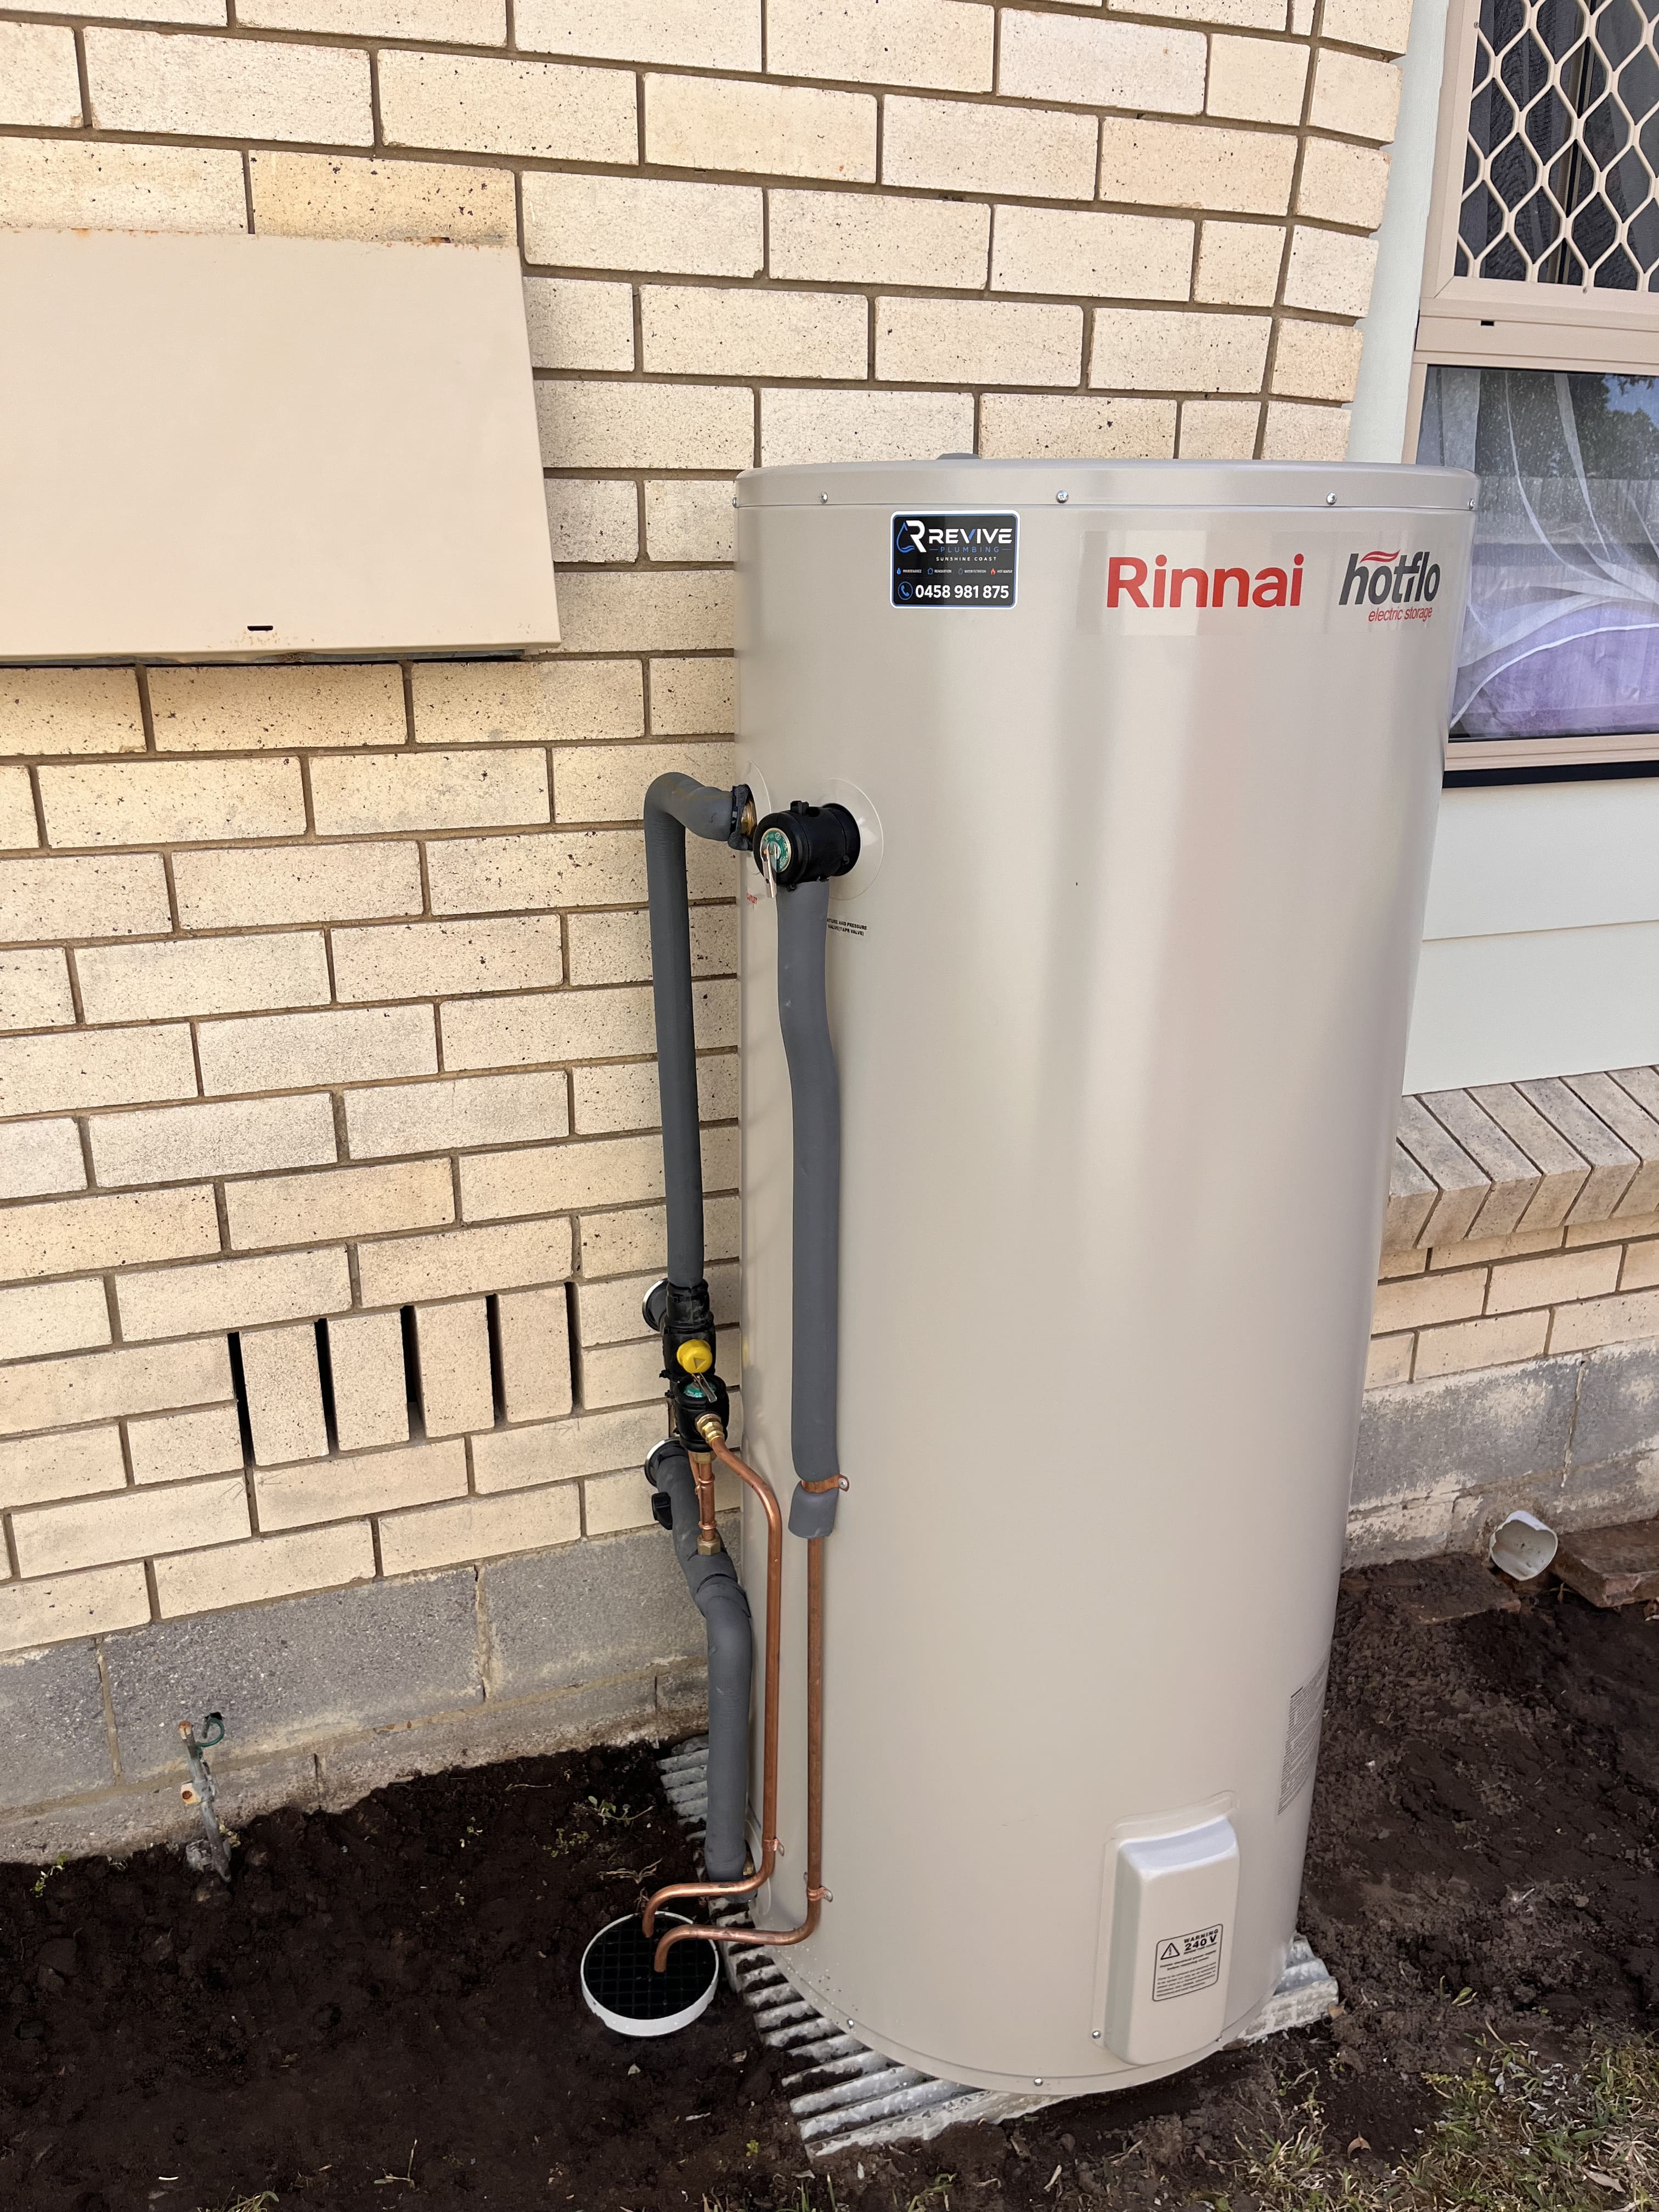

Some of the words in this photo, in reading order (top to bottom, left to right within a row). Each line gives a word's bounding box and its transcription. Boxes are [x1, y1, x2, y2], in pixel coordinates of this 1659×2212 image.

[928, 528, 1013, 544] REVIVE
[1106, 554, 1304, 608] Rinnai
[1339, 551, 1441, 605] hotflo
[915, 585, 951, 599] 0458
[954, 585, 979, 599] 981
[983, 585, 1009, 599] 875
[1368, 606, 1403, 622] electric
[1404, 606, 1433, 622] storage
[1184, 1928, 1218, 1943] WARNING
[1185, 1938, 1207, 1951] 240
[1210, 1934, 1217, 1943] V
